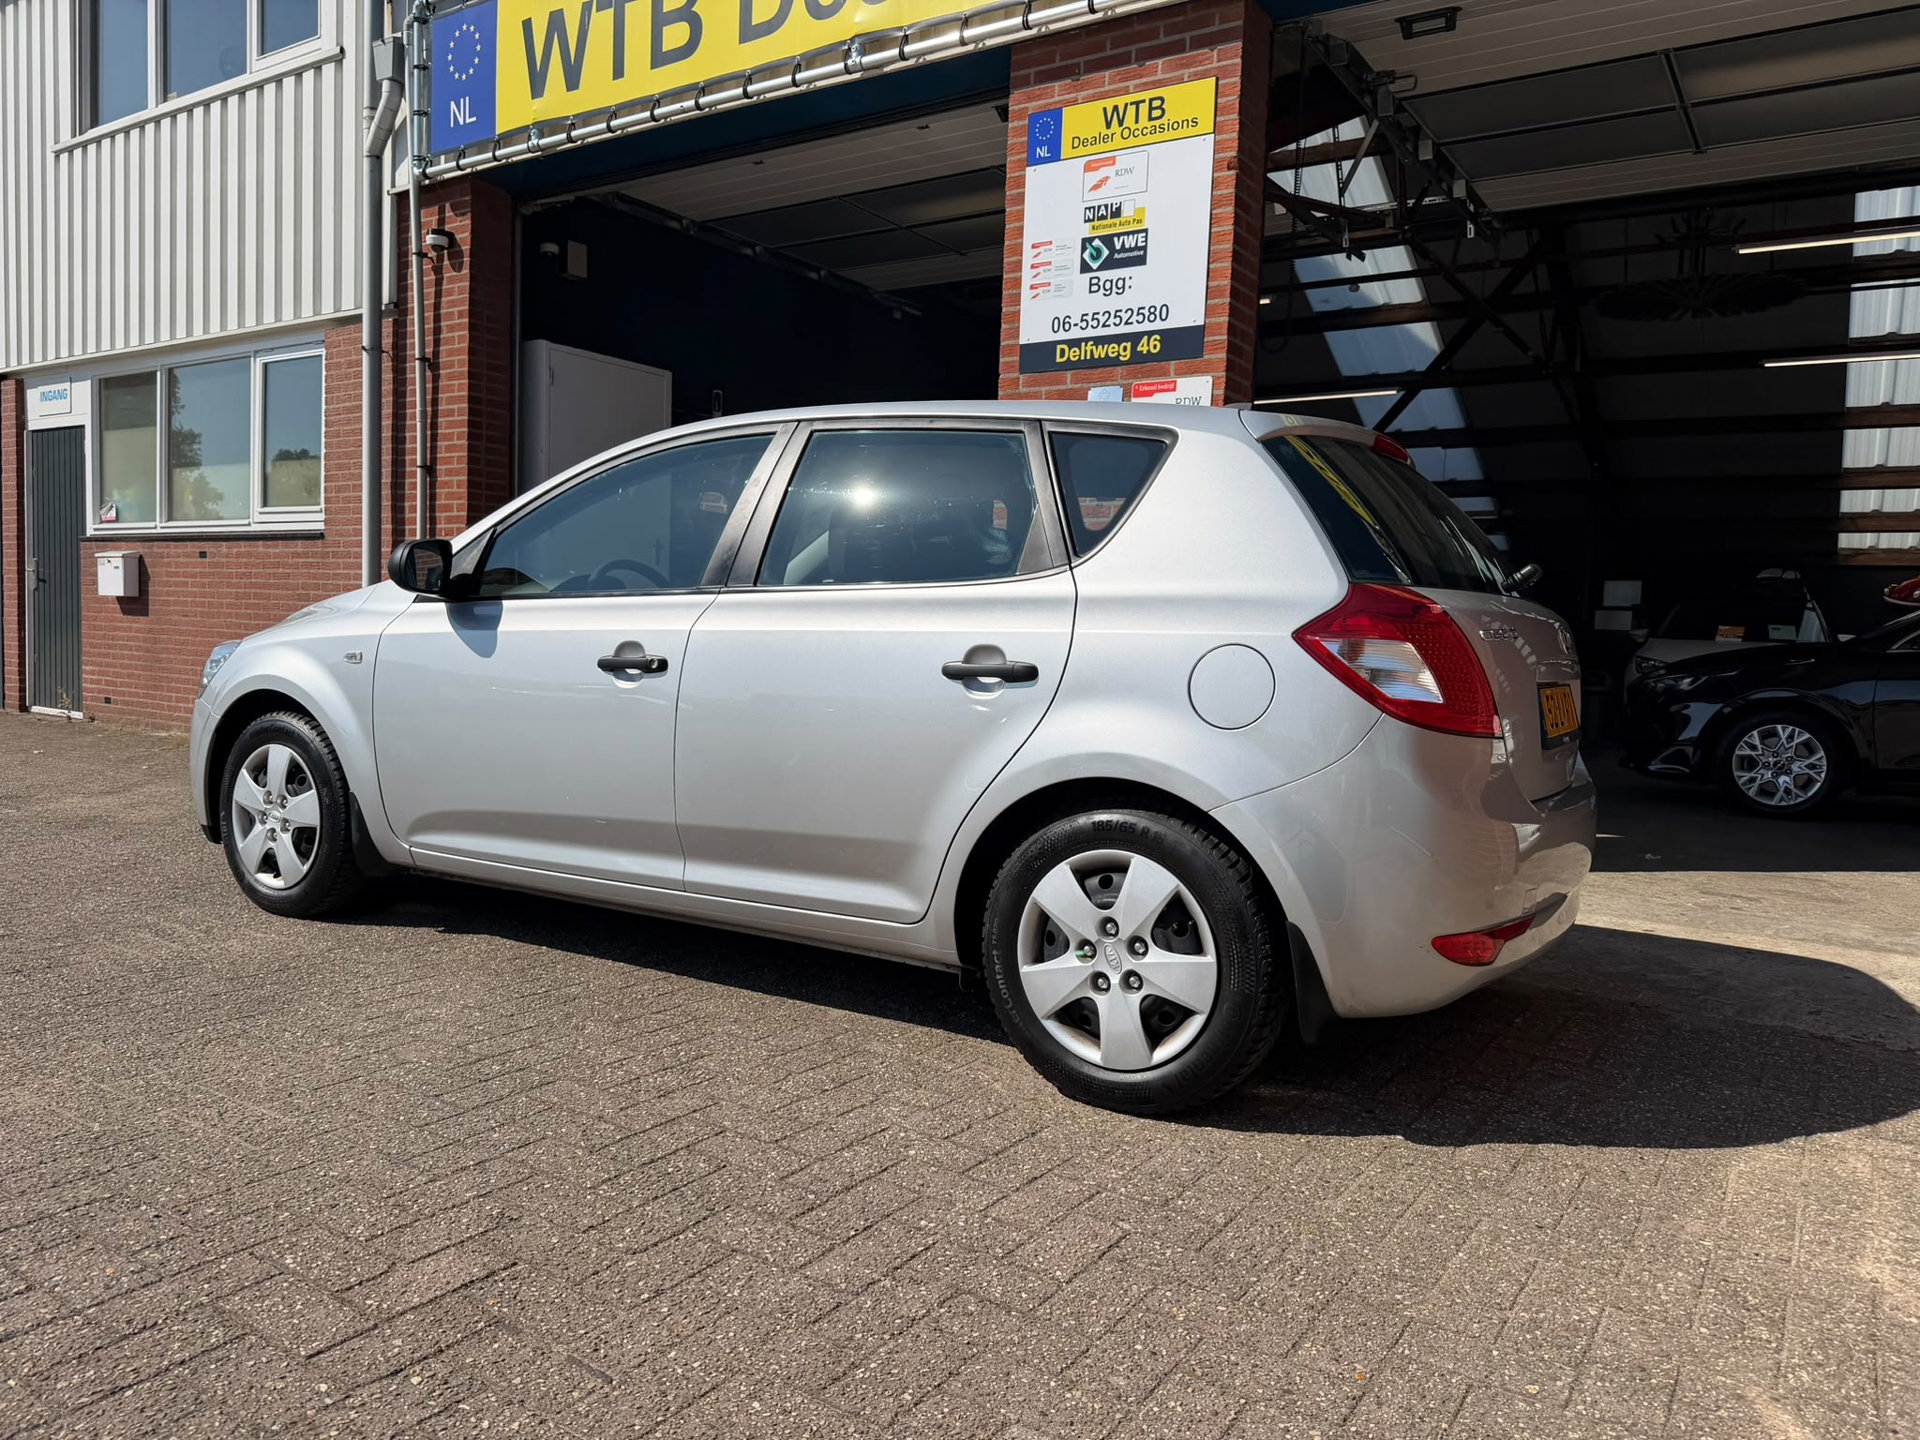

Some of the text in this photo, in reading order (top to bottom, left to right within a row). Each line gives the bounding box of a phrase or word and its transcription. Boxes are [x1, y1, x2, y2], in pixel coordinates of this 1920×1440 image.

[522, 0, 703, 100] WTB
[449, 95, 477, 128] NL
[1102, 96, 1167, 130] WTB
[1071, 116, 1199, 150] Dealer Occasions
[1036, 145, 1052, 159] NL
[1115, 166, 1135, 177] RDW
[1085, 201, 1121, 221] NAP
[1091, 218, 1143, 231] Nationale Auto Pas
[1113, 232, 1146, 250] VWE
[1113, 250, 1144, 259] Automotive
[1089, 275, 1133, 297] Bgg:
[1051, 303, 1170, 334] 06-55252580
[1055, 334, 1161, 363] Delfweg 46
[40, 388, 68, 402] INGANG
[1091, 820, 1137, 834] 185/65
